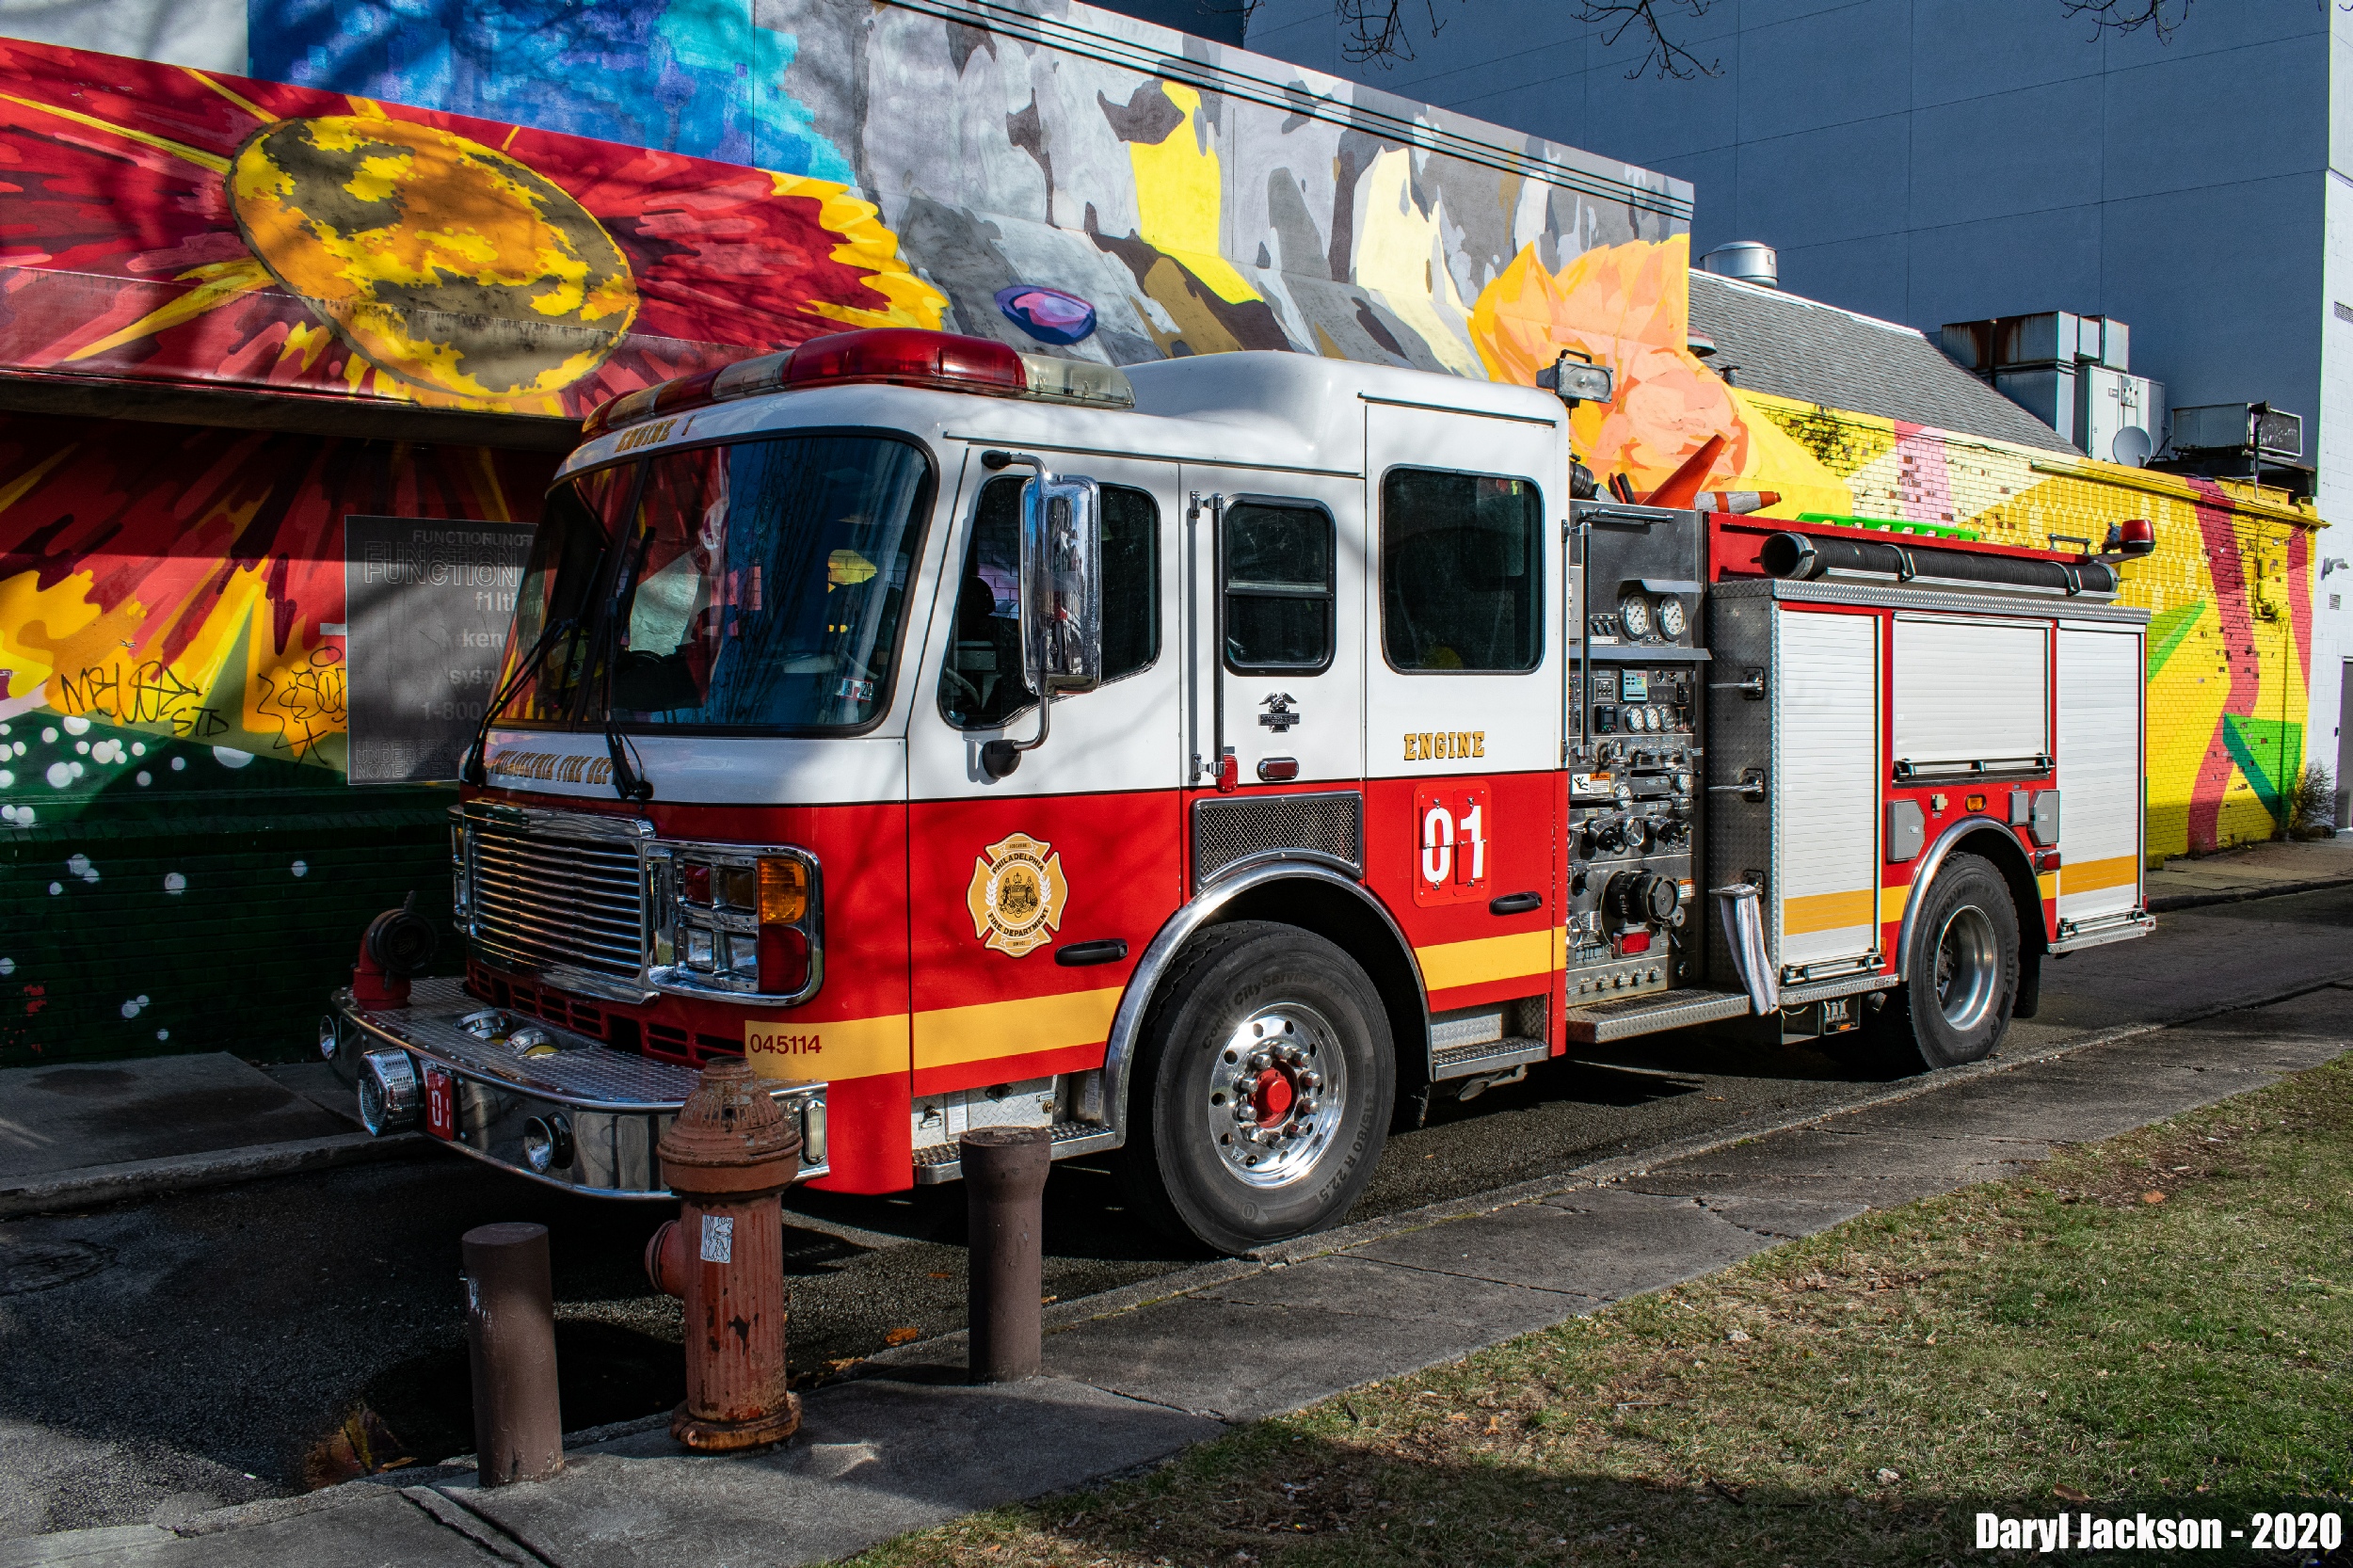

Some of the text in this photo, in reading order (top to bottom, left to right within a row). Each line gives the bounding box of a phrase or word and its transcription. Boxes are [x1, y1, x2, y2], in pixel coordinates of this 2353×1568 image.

[615, 415, 696, 453] ENGINE 1
[364, 559, 518, 587] FUNCTION
[1403, 731, 1484, 760] ENGINE
[356, 762, 452, 778] NOVEMBER
[556, 756, 593, 783] FIRE
[585, 757, 615, 785] DEP
[1422, 806, 1484, 883] 01
[992, 853, 1044, 874] PHILADELPHIA
[987, 908, 1048, 936] FIRE DEPARTMENT
[749, 1033, 823, 1055] 045114
